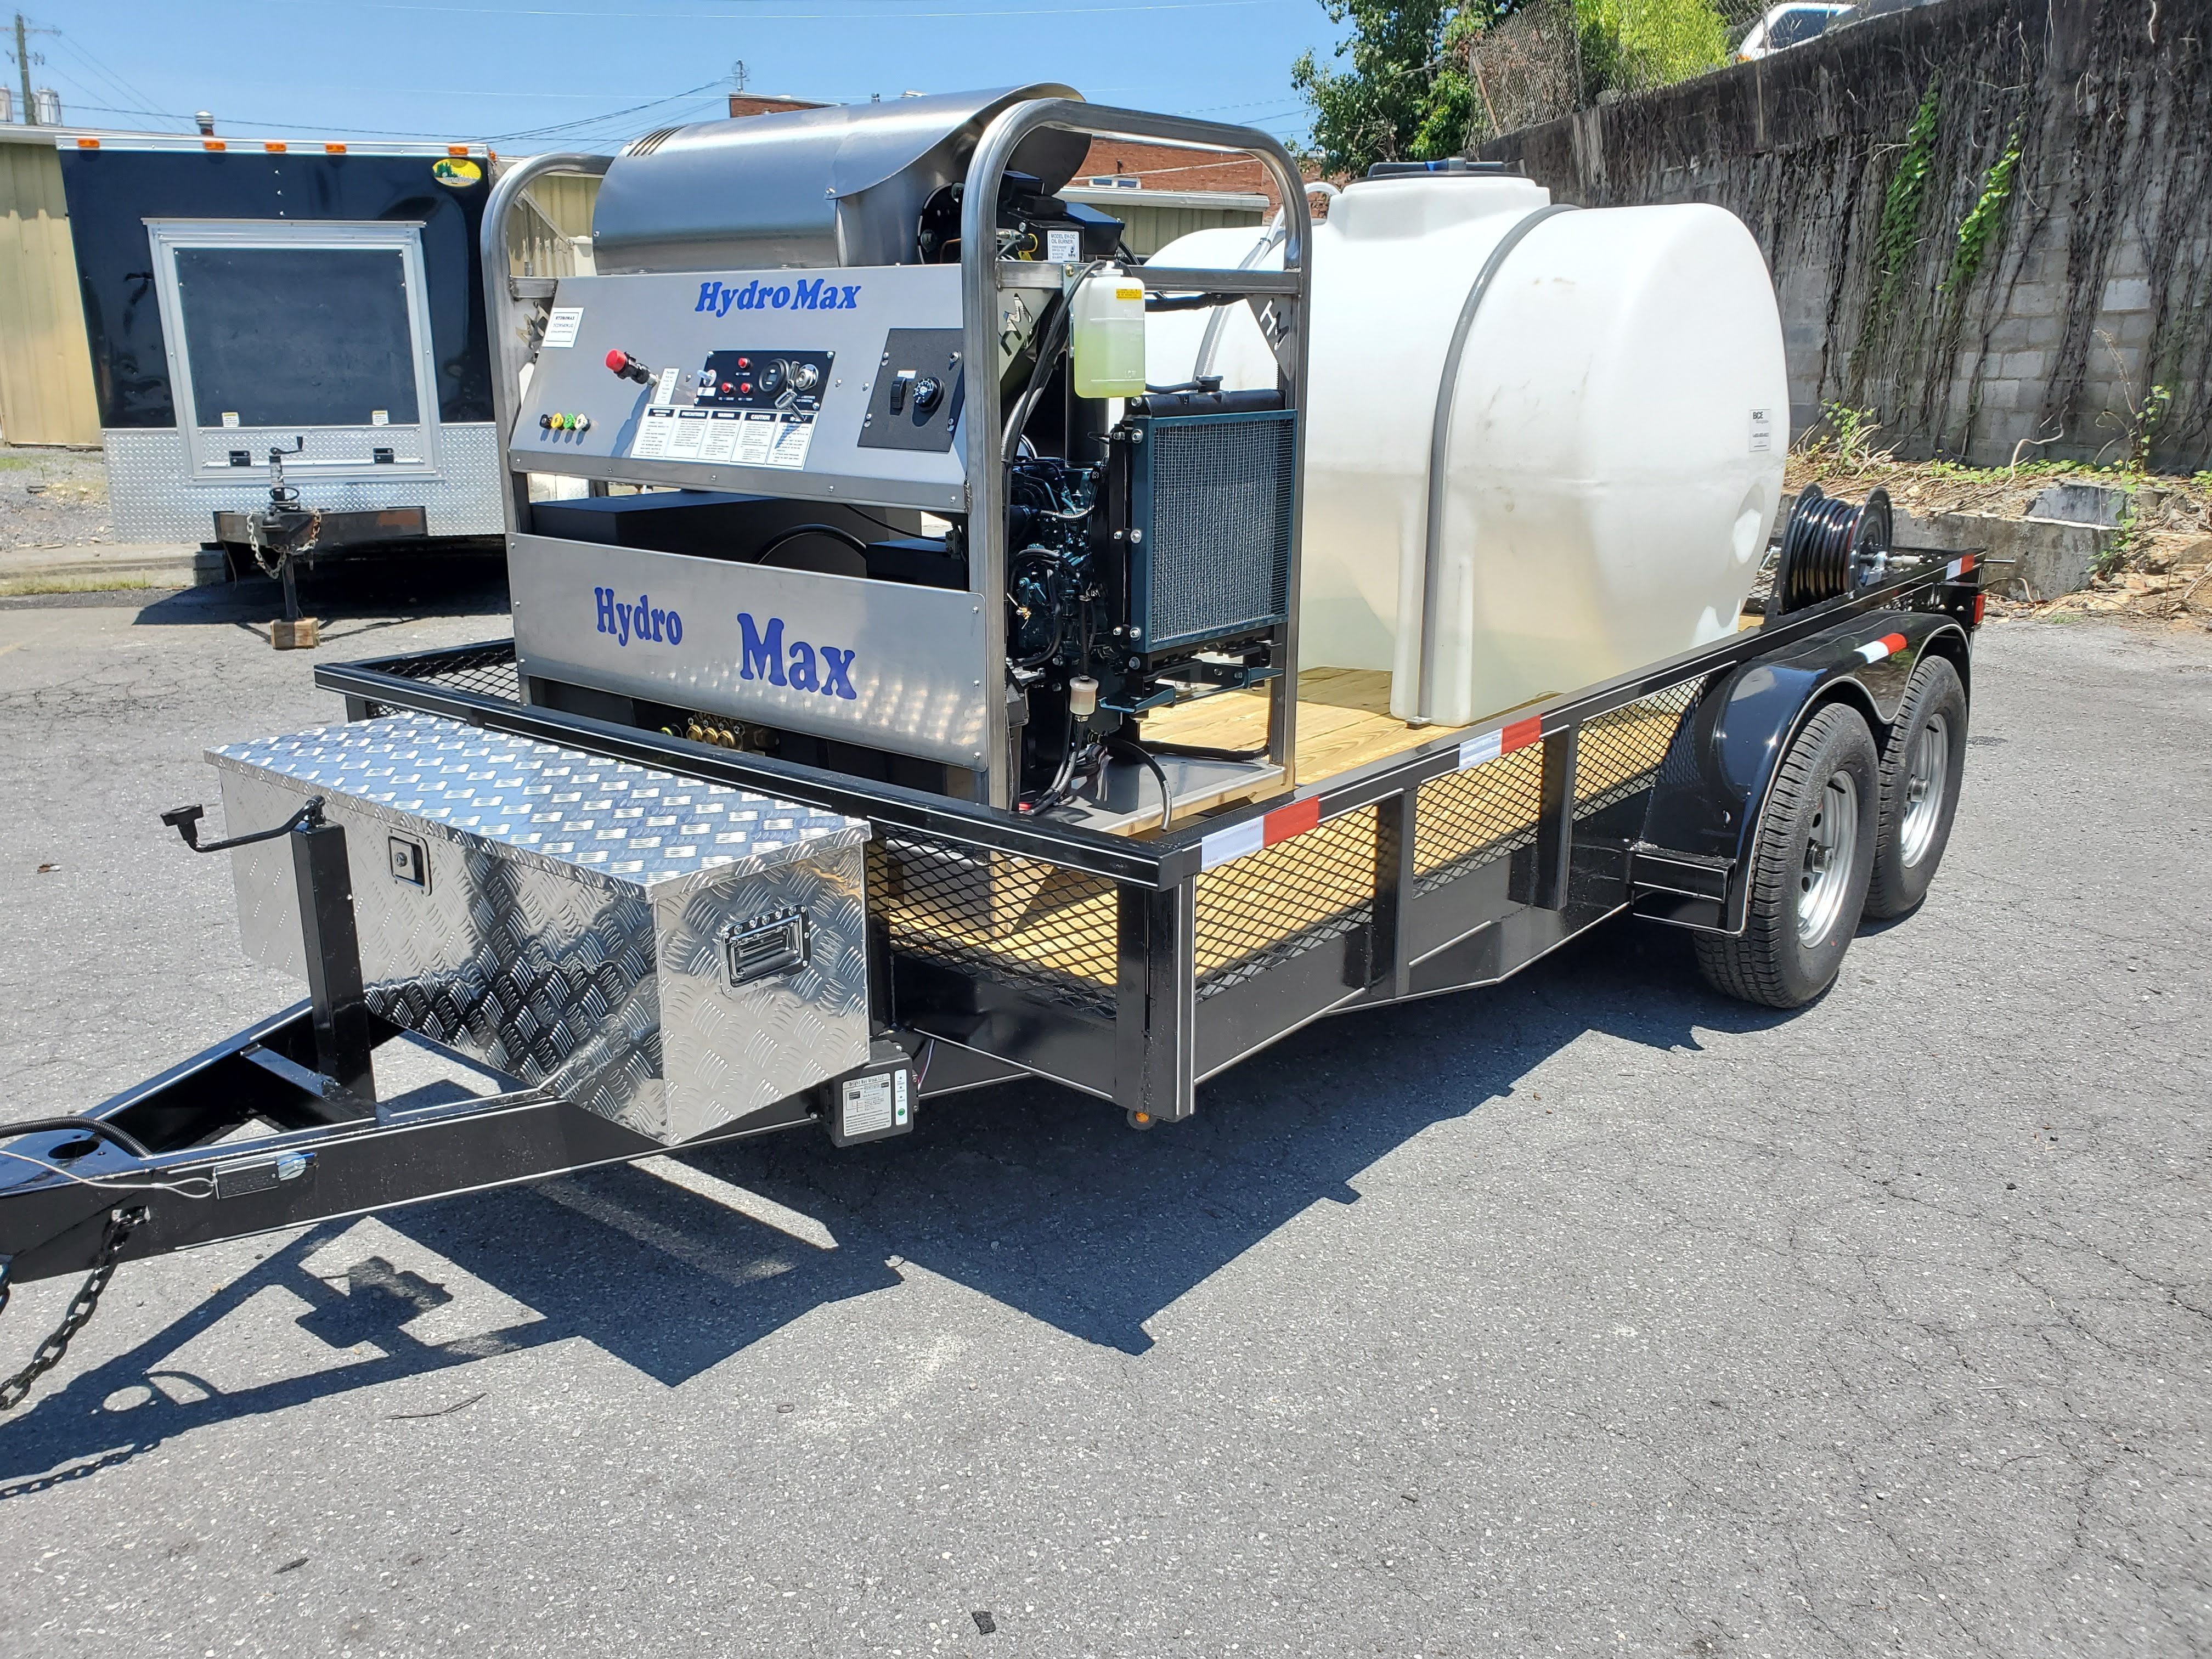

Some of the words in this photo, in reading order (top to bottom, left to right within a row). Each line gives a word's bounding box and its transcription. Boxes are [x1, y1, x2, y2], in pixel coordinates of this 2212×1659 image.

[1753, 411, 1763, 420] BCE
[594, 586, 683, 647] Hydro
[736, 612, 857, 700] Max
